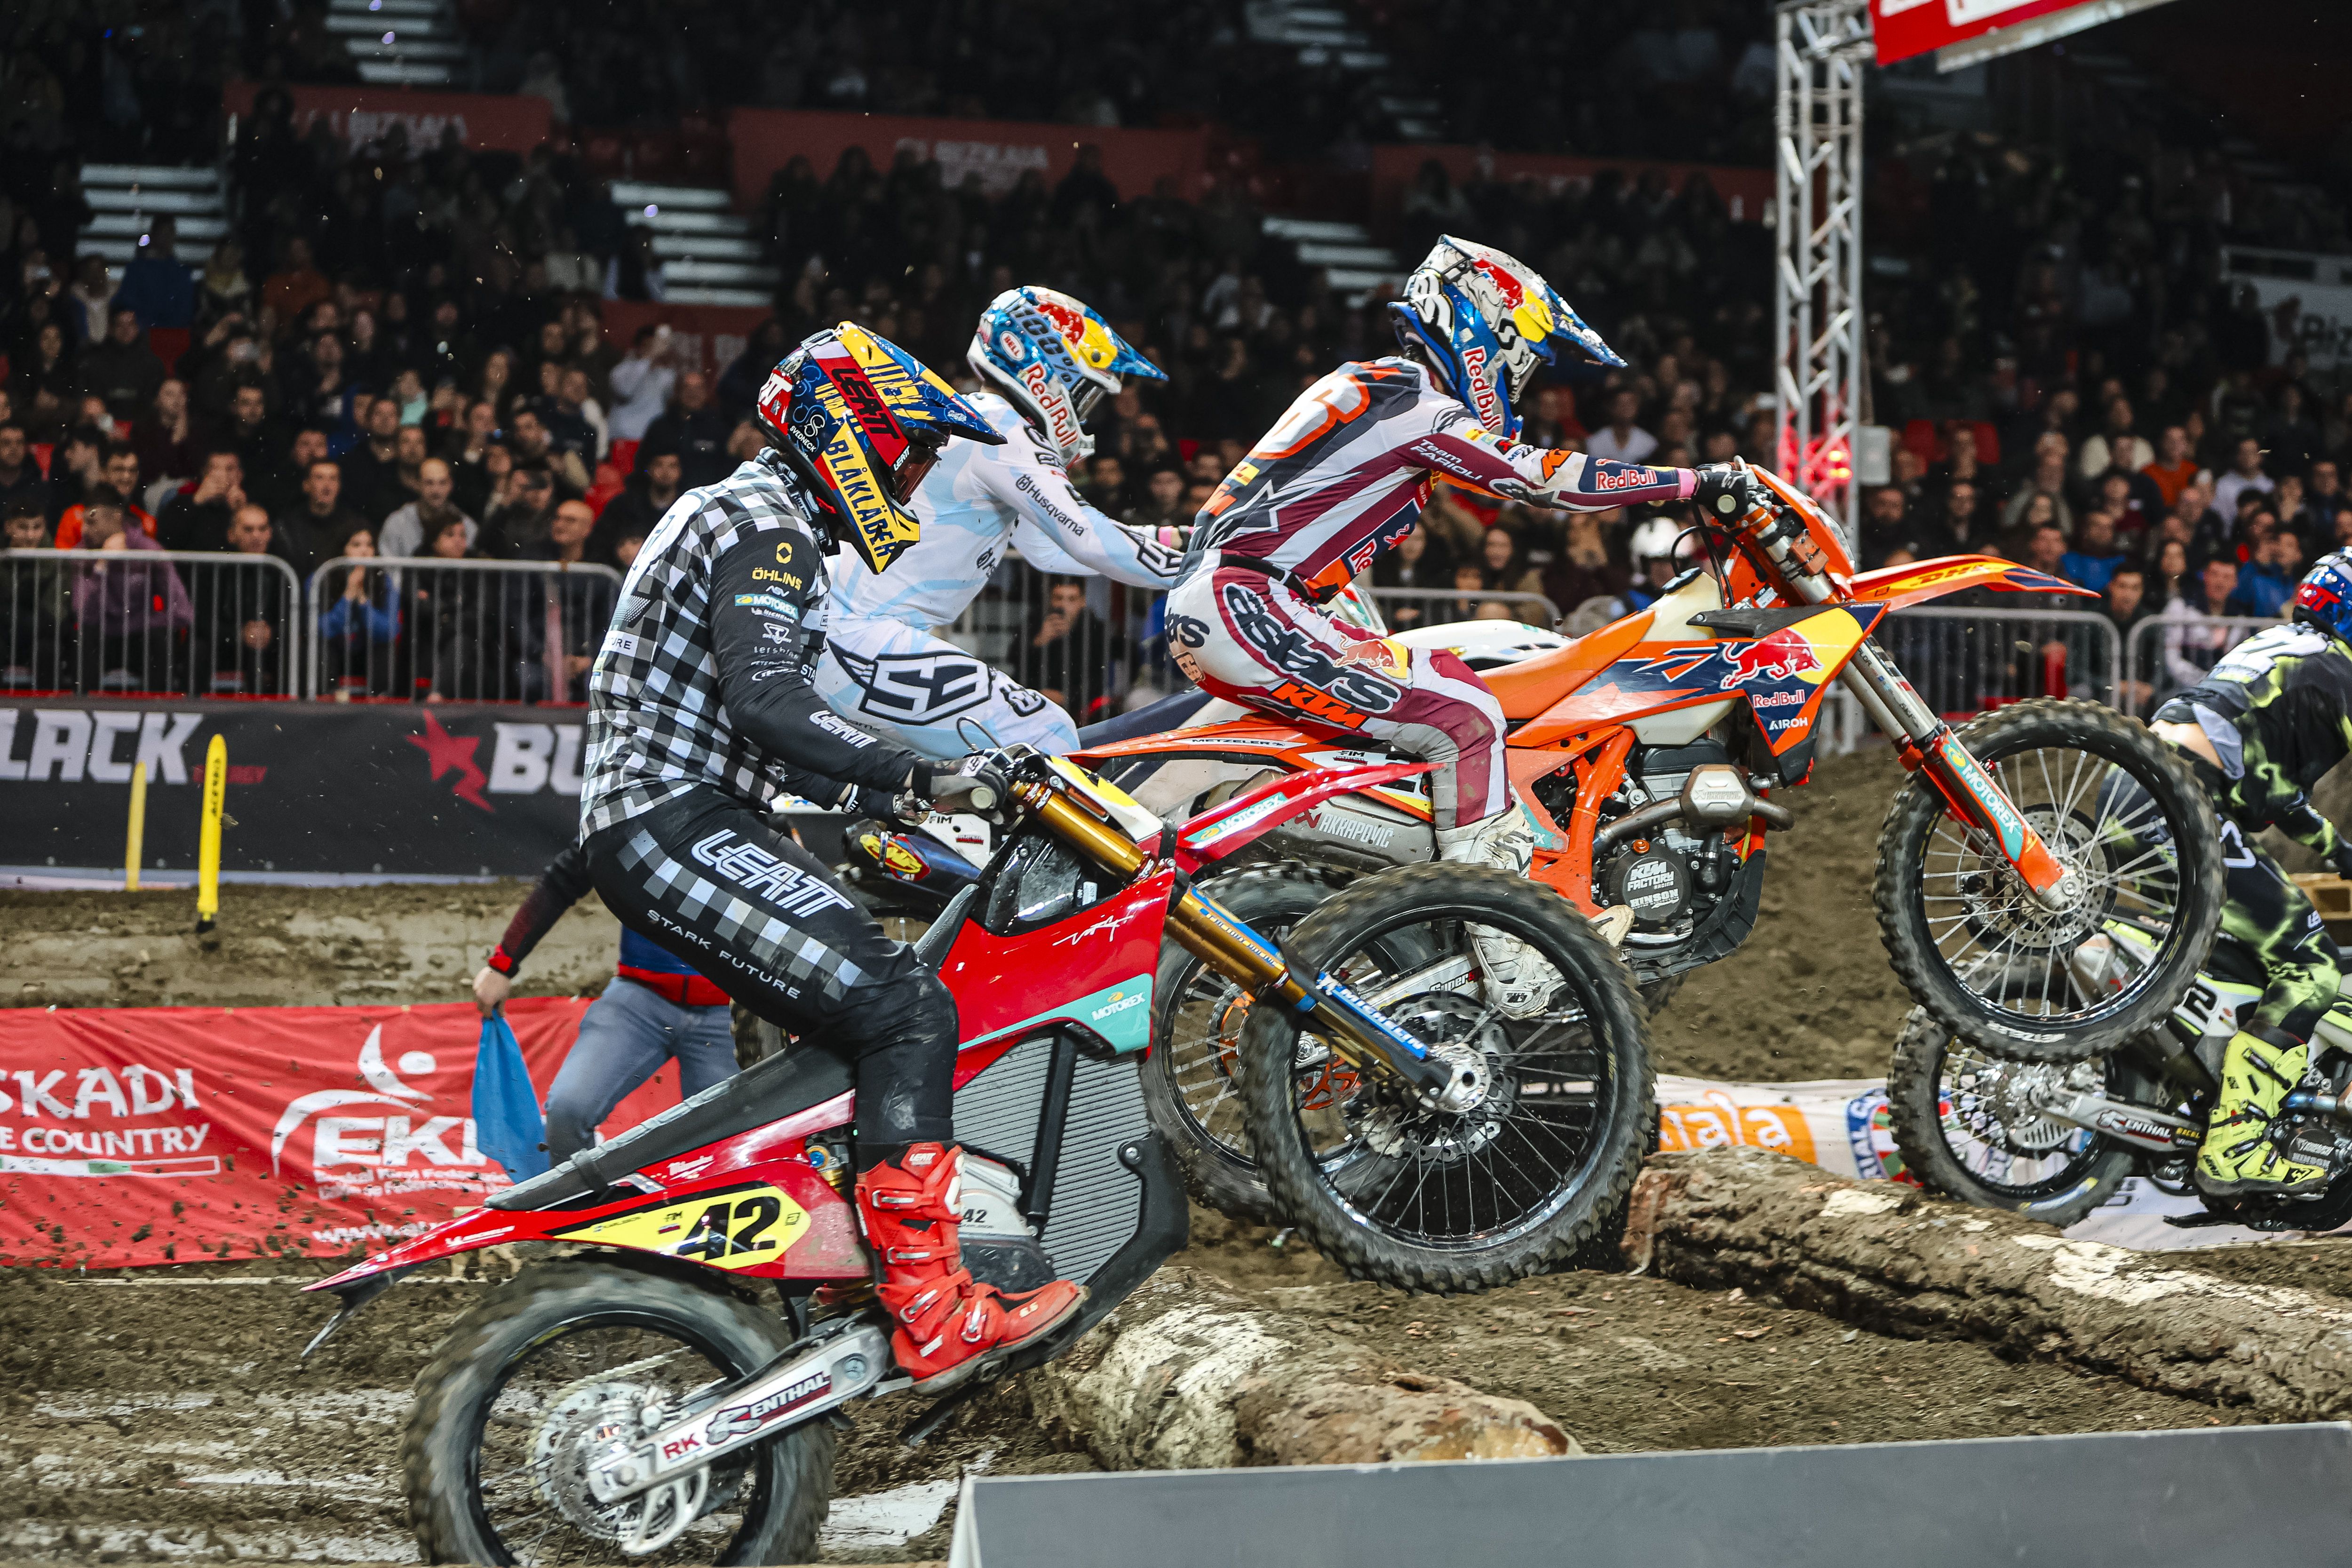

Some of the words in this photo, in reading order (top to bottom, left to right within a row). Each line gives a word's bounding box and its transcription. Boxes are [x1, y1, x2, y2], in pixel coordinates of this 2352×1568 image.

[1004, 335, 1019, 356] BELL
[1463, 347, 1490, 392] Red
[1477, 390, 1502, 431] Bull
[831, 367, 900, 439] LEATT
[1026, 362, 1062, 409] Red
[1051, 406, 1080, 448] Bull
[789, 426, 816, 453] SVEDNECK
[1422, 439, 1462, 463] Team
[894, 446, 910, 471] LEATT
[1410, 445, 1483, 480] FARIOLI
[1596, 470, 1628, 490] Red
[1628, 469, 1657, 486] Bull
[826, 439, 898, 557] BLÅKLÄDER
[1027, 485, 1084, 536] Husqvarna
[752, 567, 802, 591] ÖHLINS
[754, 596, 796, 616] MOTOREX
[1270, 682, 1369, 729] KTM
[1753, 692, 1779, 708] Red
[1780, 690, 1805, 706] Bull
[1769, 717, 1808, 730] AIROH
[1963, 764, 2019, 833] MOTOREX
[691, 828, 855, 918] LEATT
[1628, 871, 1674, 891] FACTORY
[1630, 861, 1666, 880] KTM
[1630, 889, 1678, 907] HINSON
[1654, 881, 1674, 890] RACING
[647, 909, 712, 949] STARK
[719, 950, 801, 1000] FUTURE
[1091, 992, 1146, 1021] MOTOREX
[1339, 988, 1424, 1050] MICHELIN
[22, 1123, 210, 1156] COUNTRY
[909, 1153, 936, 1162] LEATT
[678, 1196, 780, 1261] 42
[963, 1209, 987, 1223] 42
[663, 1433, 700, 1460] RK
